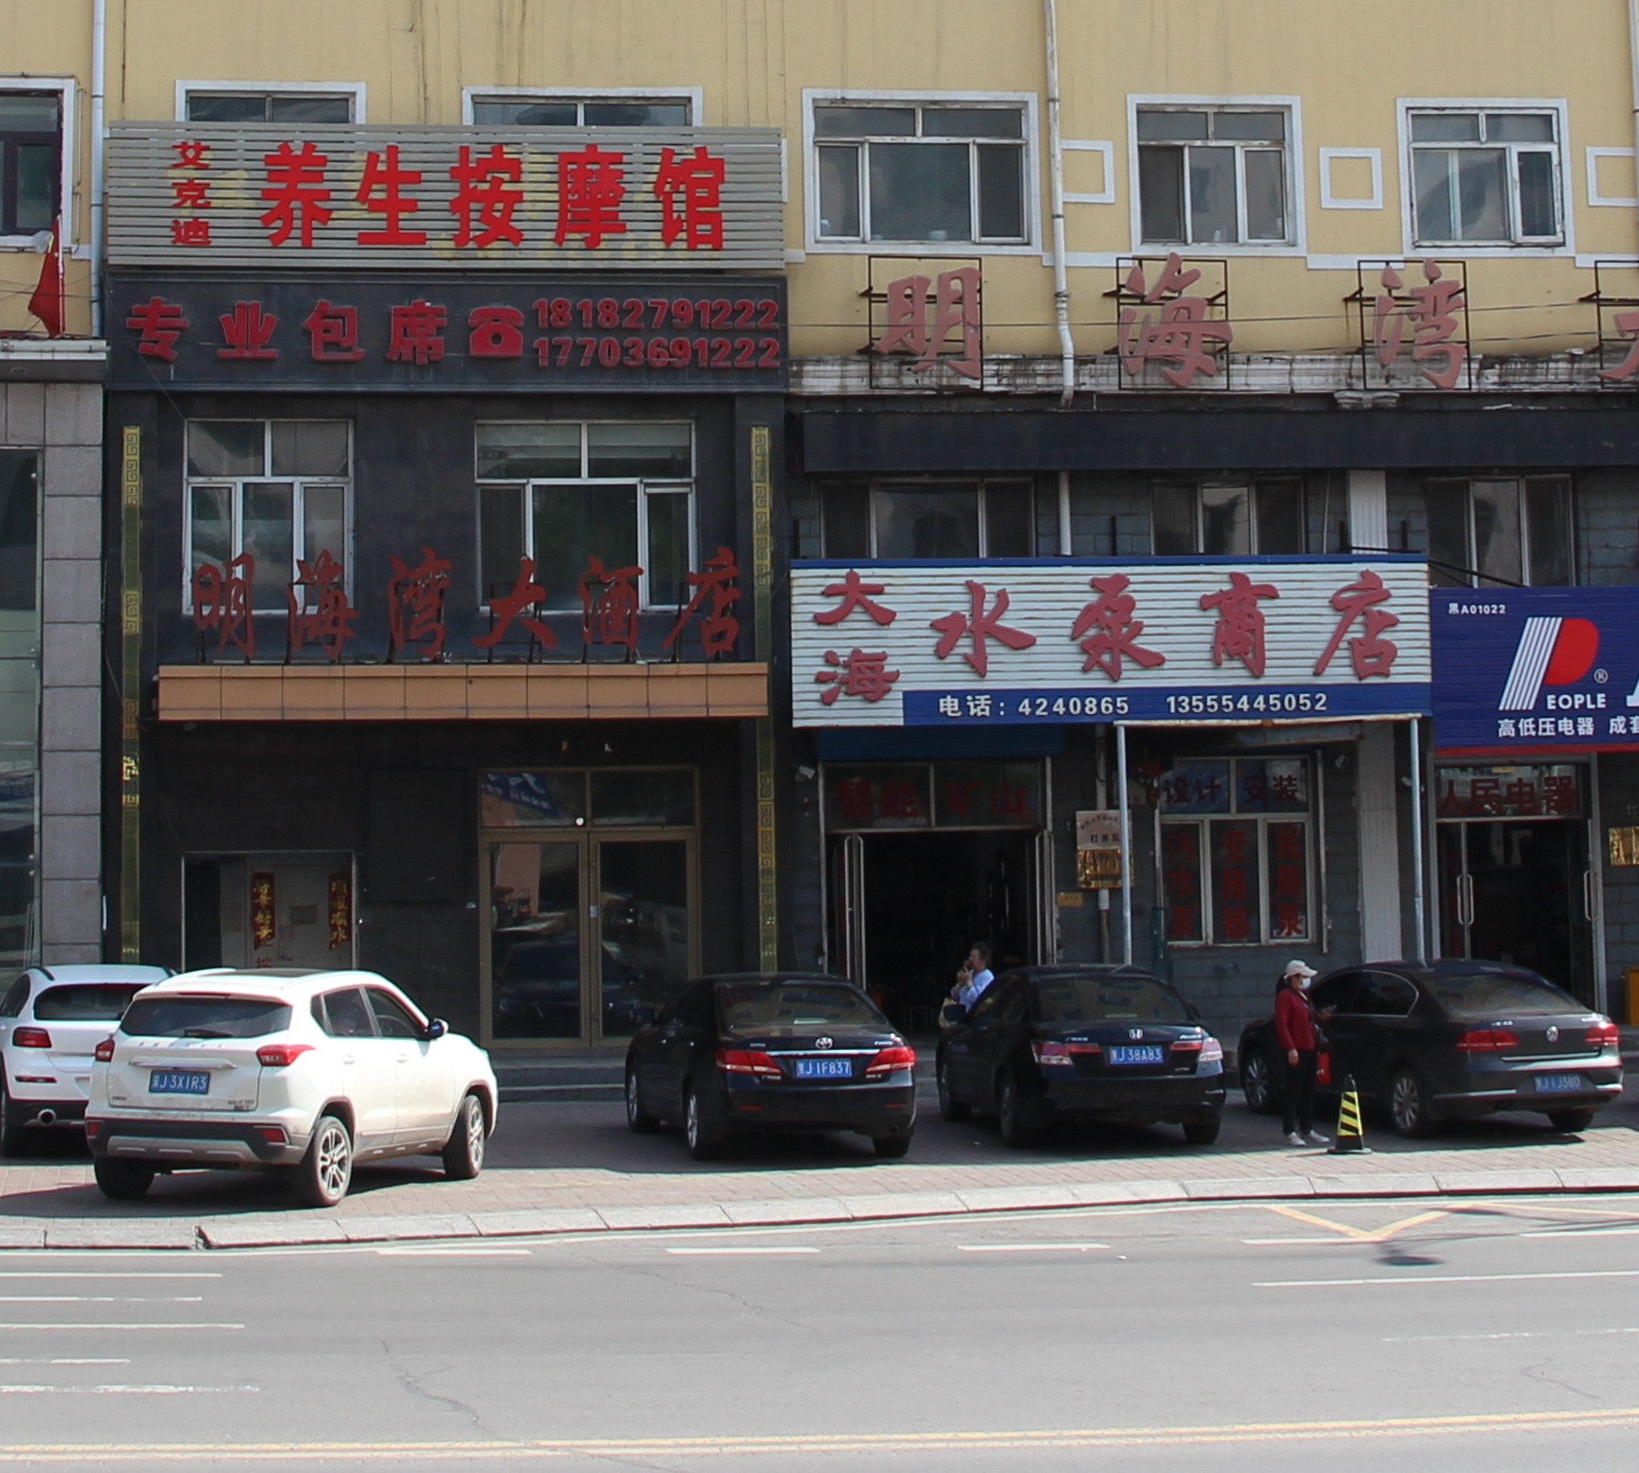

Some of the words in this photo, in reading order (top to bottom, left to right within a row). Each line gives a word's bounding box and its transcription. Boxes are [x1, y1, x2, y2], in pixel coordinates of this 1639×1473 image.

[171, 141, 212, 246] 艾克迪
[259, 142, 726, 250] 养生按摩馆
[126, 296, 449, 365] 专业包席
[533, 298, 779, 332] 18182791222
[533, 336, 780, 369] 17703691222
[189, 547, 744, 659] 明海湾大酒店
[930, 570, 1402, 681] 水泵商店
[814, 570, 899, 706] 大海
[1018, 695, 1130, 716] 4240865
[1165, 693, 1328, 714] 13555445052
[1497, 716, 1595, 738] 高低压电器
[1437, 775, 1576, 814] 人民电器
